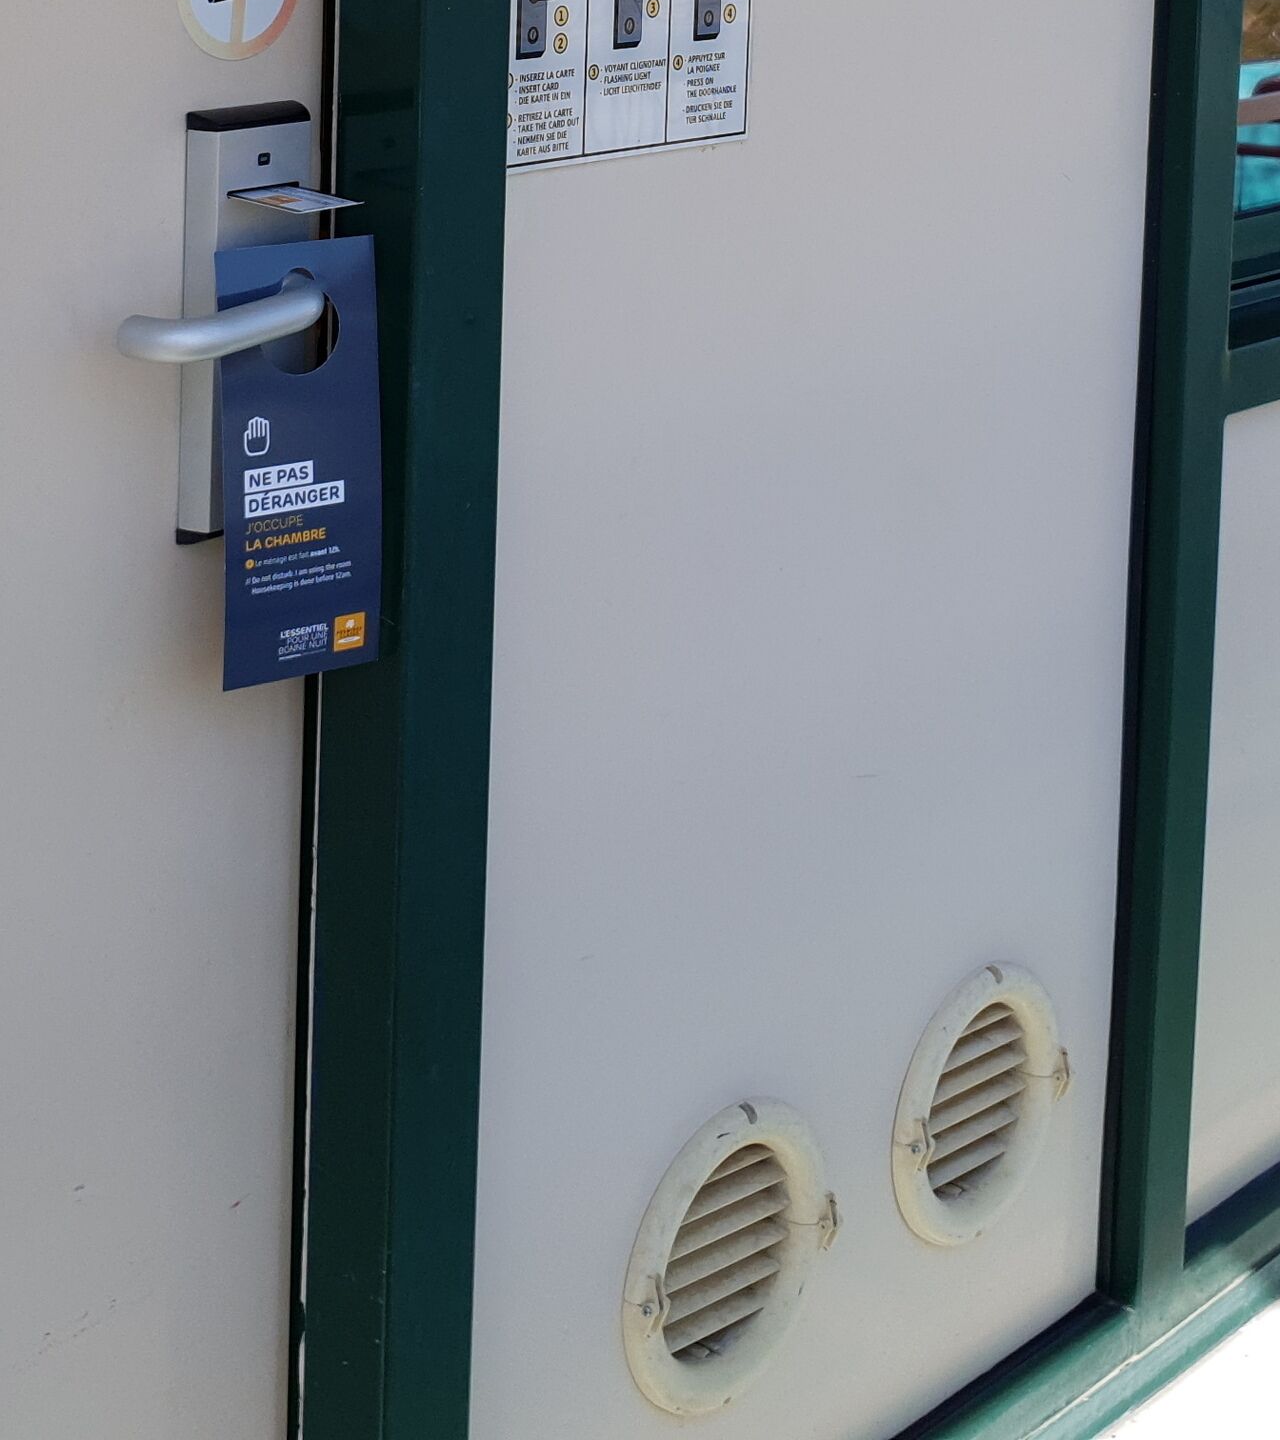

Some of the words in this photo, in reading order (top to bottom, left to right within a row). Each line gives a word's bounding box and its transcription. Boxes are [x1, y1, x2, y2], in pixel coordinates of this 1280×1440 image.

[559, 10, 563, 21] 1
[558, 38, 563, 49] 2
[688, 53, 713, 63] APPUYEZ
[605, 63, 628, 73] VOYANT
[630, 59, 666, 70] CLIGNOTANT
[520, 72, 544, 83] INSEREZ
[546, 71, 554, 79] LA
[556, 69, 575, 78] CARTE
[604, 74, 632, 84] FLASHING
[634, 72, 651, 80] LIGHT
[687, 78, 703, 87] PRESS
[705, 77, 713, 85] ON
[519, 83, 540, 94] INSERT
[542, 82, 559, 91] CARD
[604, 87, 620, 96] LICHT
[687, 90, 697, 98] THE
[519, 96, 529, 105] DIE
[531, 93, 550, 103] KARTE
[552, 92, 558, 100] IN
[561, 91, 571, 99] EIN
[714, 101, 722, 109] SIE
[544, 111, 552, 119] LA
[554, 108, 573, 117] CARTE
[518, 124, 533, 133] TAKE
[536, 122, 546, 130] THE
[548, 120, 565, 129] CARD
[567, 117, 579, 127] OUT
[546, 132, 555, 140] SIE
[557, 130, 567, 138] DIE
[517, 147, 536, 157] KARTE
[538, 145, 550, 153] AUS
[552, 142, 569, 152] BITTE
[249, 471, 272, 488] NE
[277, 466, 309, 483] PAS
[249, 486, 339, 512] DÉRANGER
[246, 539, 262, 552] LA
[265, 527, 326, 548] CHAMBRE
